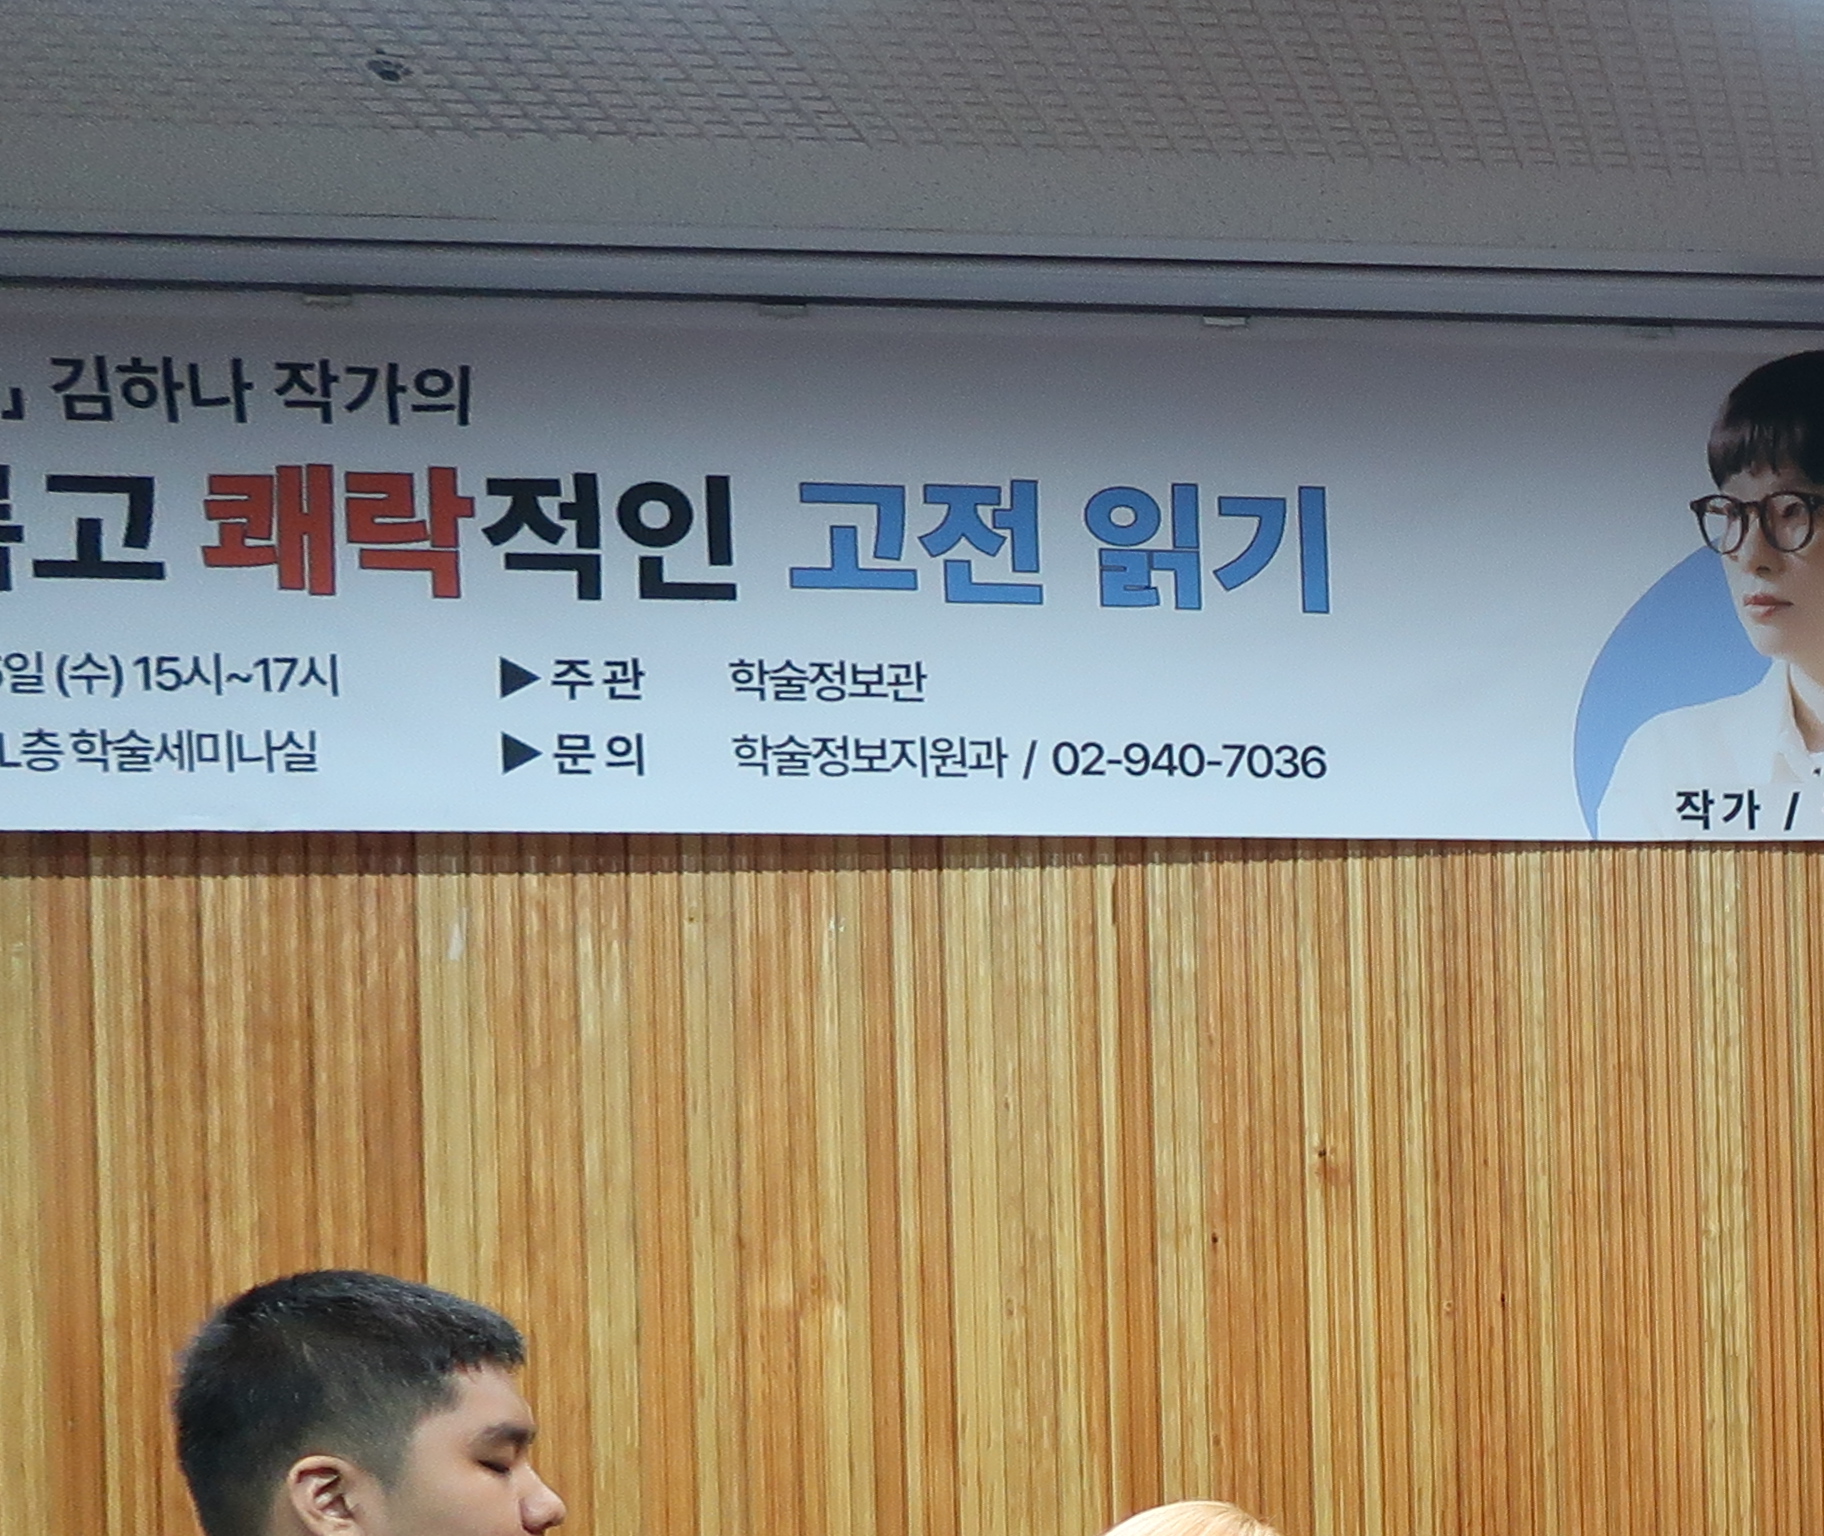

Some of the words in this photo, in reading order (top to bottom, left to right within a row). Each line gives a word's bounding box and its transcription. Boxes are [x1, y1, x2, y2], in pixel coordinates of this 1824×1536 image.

[50, 355, 254, 424] 김하나
[273, 359, 471, 427] 작가의
[202, 463, 738, 602] 쾌락적인
[788, 479, 1044, 605] 고전
[1083, 482, 1331, 614] 읽기
[0, 651, 46, 695] 일
[55, 653, 124, 698] (수)
[132, 652, 340, 698] 15시~17시
[728, 658, 928, 703] 학술정보관
[68, 728, 318, 774] 학술세미나실
[731, 733, 1008, 779] 학술정보지원과
[1051, 740, 1328, 780] 02-940-7036
[1676, 788, 1761, 831] 작가
